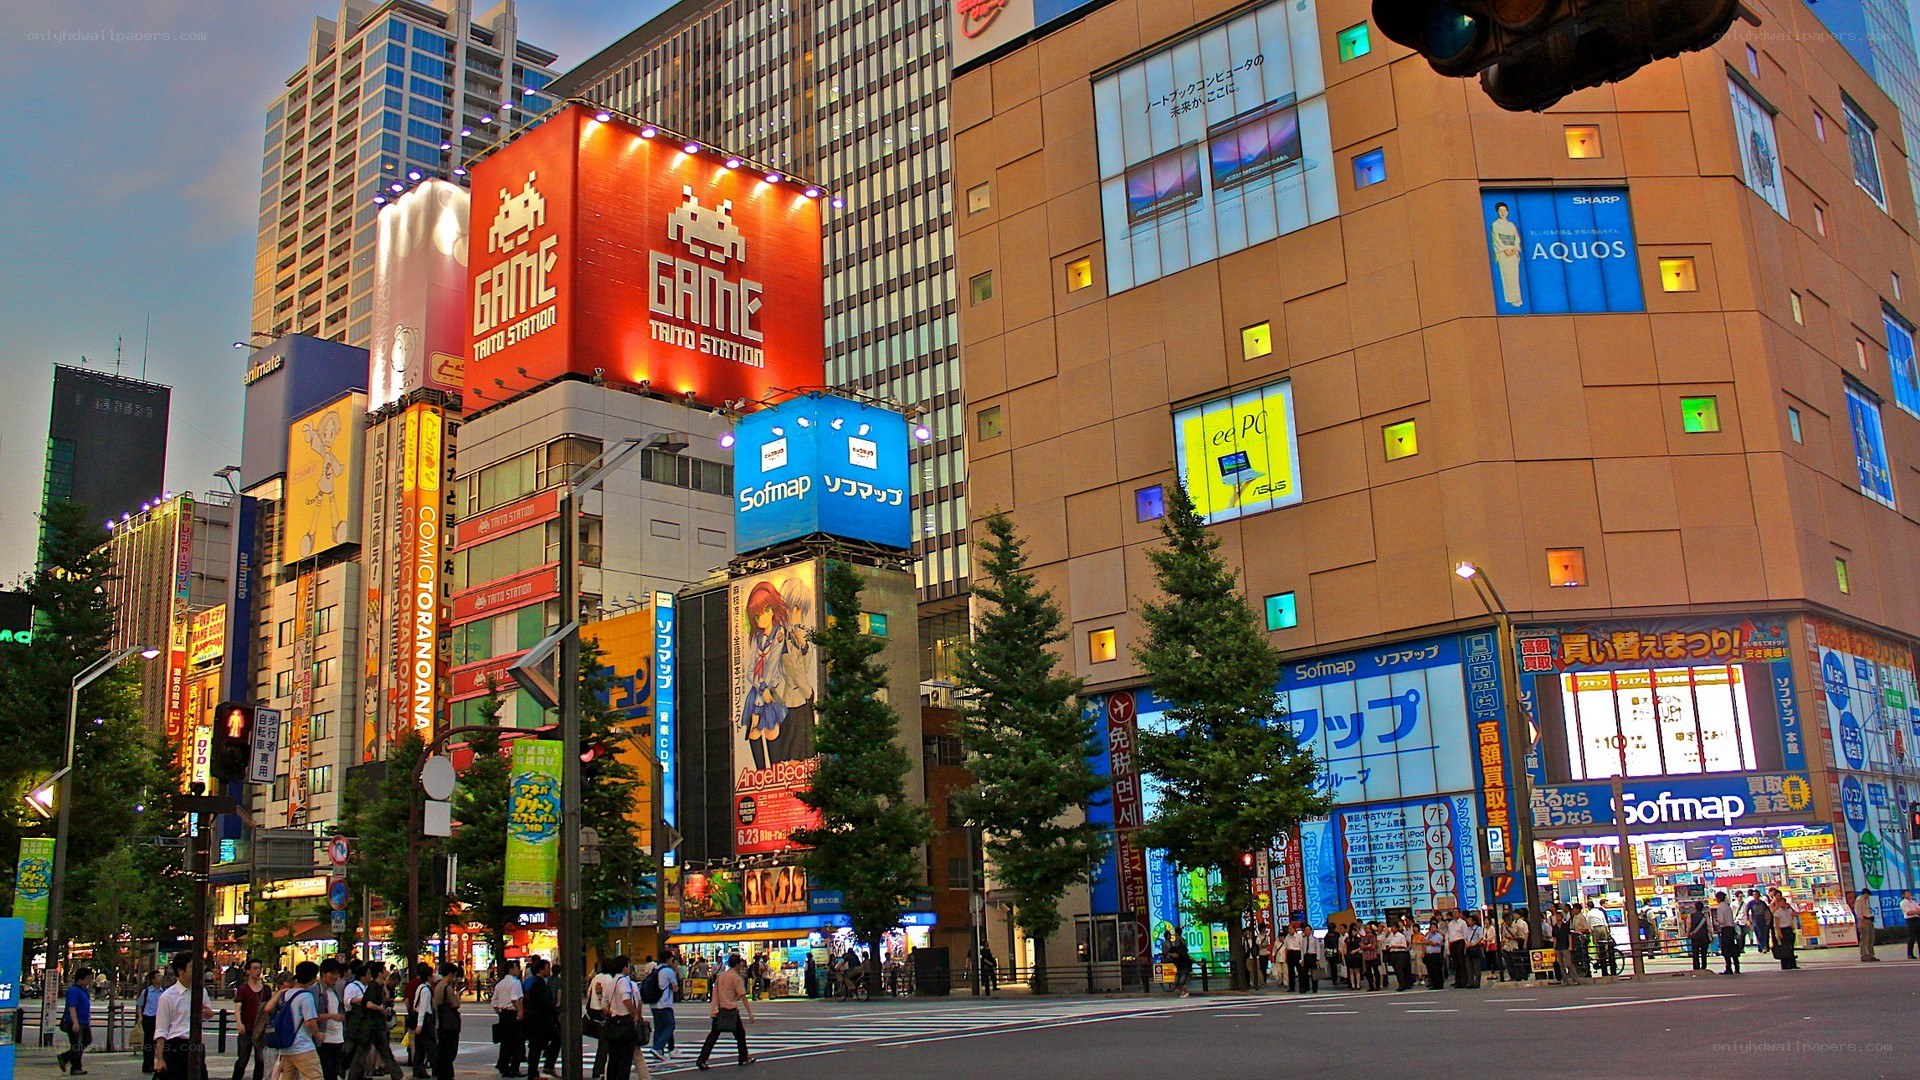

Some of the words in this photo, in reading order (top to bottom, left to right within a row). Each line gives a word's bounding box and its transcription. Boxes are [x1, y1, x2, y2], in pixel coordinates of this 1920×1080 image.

[1145, 54, 1264, 113] ノートブックコンピュータの
[1170, 83, 1239, 118] 未来が、ここに。
[1573, 196, 1620, 205] SHARP
[1532, 240, 1626, 263] AQUOS
[474, 234, 559, 336] GAME
[648, 249, 763, 343] GAME
[473, 325, 505, 361] TAITO
[507, 306, 557, 348] STATION
[649, 318, 696, 351] TAITO
[699, 333, 765, 369] STATION
[243, 354, 285, 386] animate
[1242, 411, 1268, 438] PC
[740, 475, 811, 512] Sofmap
[824, 475, 903, 506] ソフマップ
[1252, 480, 1287, 496] ASUS
[491, 516, 507, 527] TAITO
[509, 505, 534, 522] STATION
[177, 503, 192, 593] 東京レジャーランド
[238, 552, 249, 599] animate
[488, 593, 503, 606] TAITO
[505, 583, 532, 601] STATION
[414, 506, 436, 731] COMICTORANOANA
[657, 620, 673, 689] ソフマップ
[1374, 645, 1439, 667] ソフマップ
[1521, 638, 1551, 655] 高額
[1560, 629, 1741, 666] 買い替えまつり!
[1295, 660, 1356, 681] Sofmap
[1468, 655, 1493, 663] パソコン
[1523, 655, 1553, 671] 買取
[1826, 664, 1844, 684] Mac
[1471, 682, 1496, 691] デジカメ
[1477, 710, 1496, 718] ゲーム
[1777, 678, 1795, 727] ソフマップ
[256, 714, 267, 750] 自転車
[266, 715, 277, 752] 歩行者
[660, 711, 670, 773] 音楽CD館
[1785, 732, 1799, 754] 本館
[197, 740, 207, 764] DVD
[1110, 727, 1131, 775] 免税
[258, 753, 269, 777] 専用
[735, 764, 777, 792] Angel
[1748, 776, 1782, 794] 買取
[1116, 776, 1138, 827] 면세
[1530, 788, 1589, 807] 売るなら
[1788, 780, 1803, 804] 無料
[515, 796, 553, 813] グリーン
[1429, 807, 1444, 821] 7F
[1611, 791, 1745, 826] Sofmap
[1752, 795, 1789, 813] 査定
[1533, 807, 1593, 827] 買うなら
[738, 828, 759, 846] 6.23
[1349, 833, 1404, 845] デジタルオーディオ
[1408, 830, 1424, 838] iPod
[1431, 829, 1446, 843] 6F
[1489, 830, 1499, 849] P
[1742, 836, 1758, 845] 500
[1121, 844, 1131, 881] TRAVEL
[1433, 852, 1448, 866] 5F
[1352, 877, 1391, 887] パソコン本体
[1400, 883, 1425, 892] プリンタ
[1436, 875, 1450, 888] 4F
[1133, 876, 1146, 915] FREE
